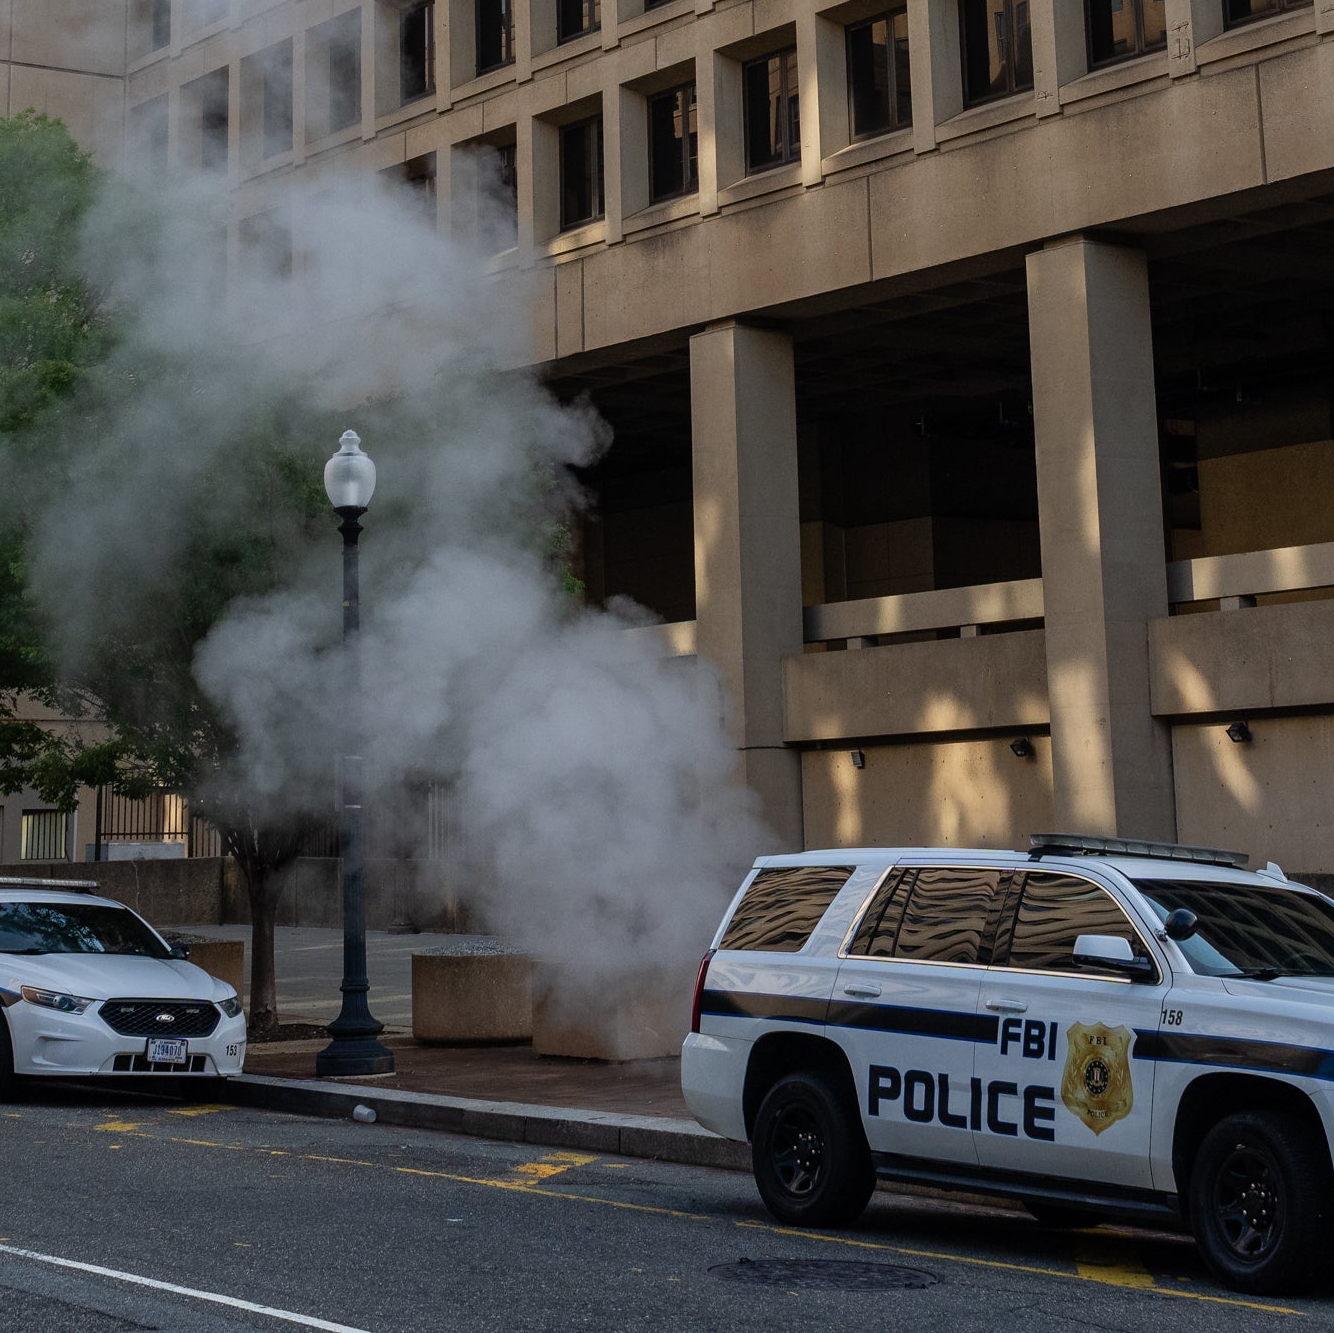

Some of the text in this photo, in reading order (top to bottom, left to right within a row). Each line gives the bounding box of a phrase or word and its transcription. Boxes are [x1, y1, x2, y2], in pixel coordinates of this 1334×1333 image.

[1161, 1009, 1183, 1026] 158
[1000, 1017, 1058, 1060] FBI
[1089, 1035, 1108, 1046] FBI
[226, 1045, 237, 1057] 153
[868, 1064, 1055, 1142] POLICE
